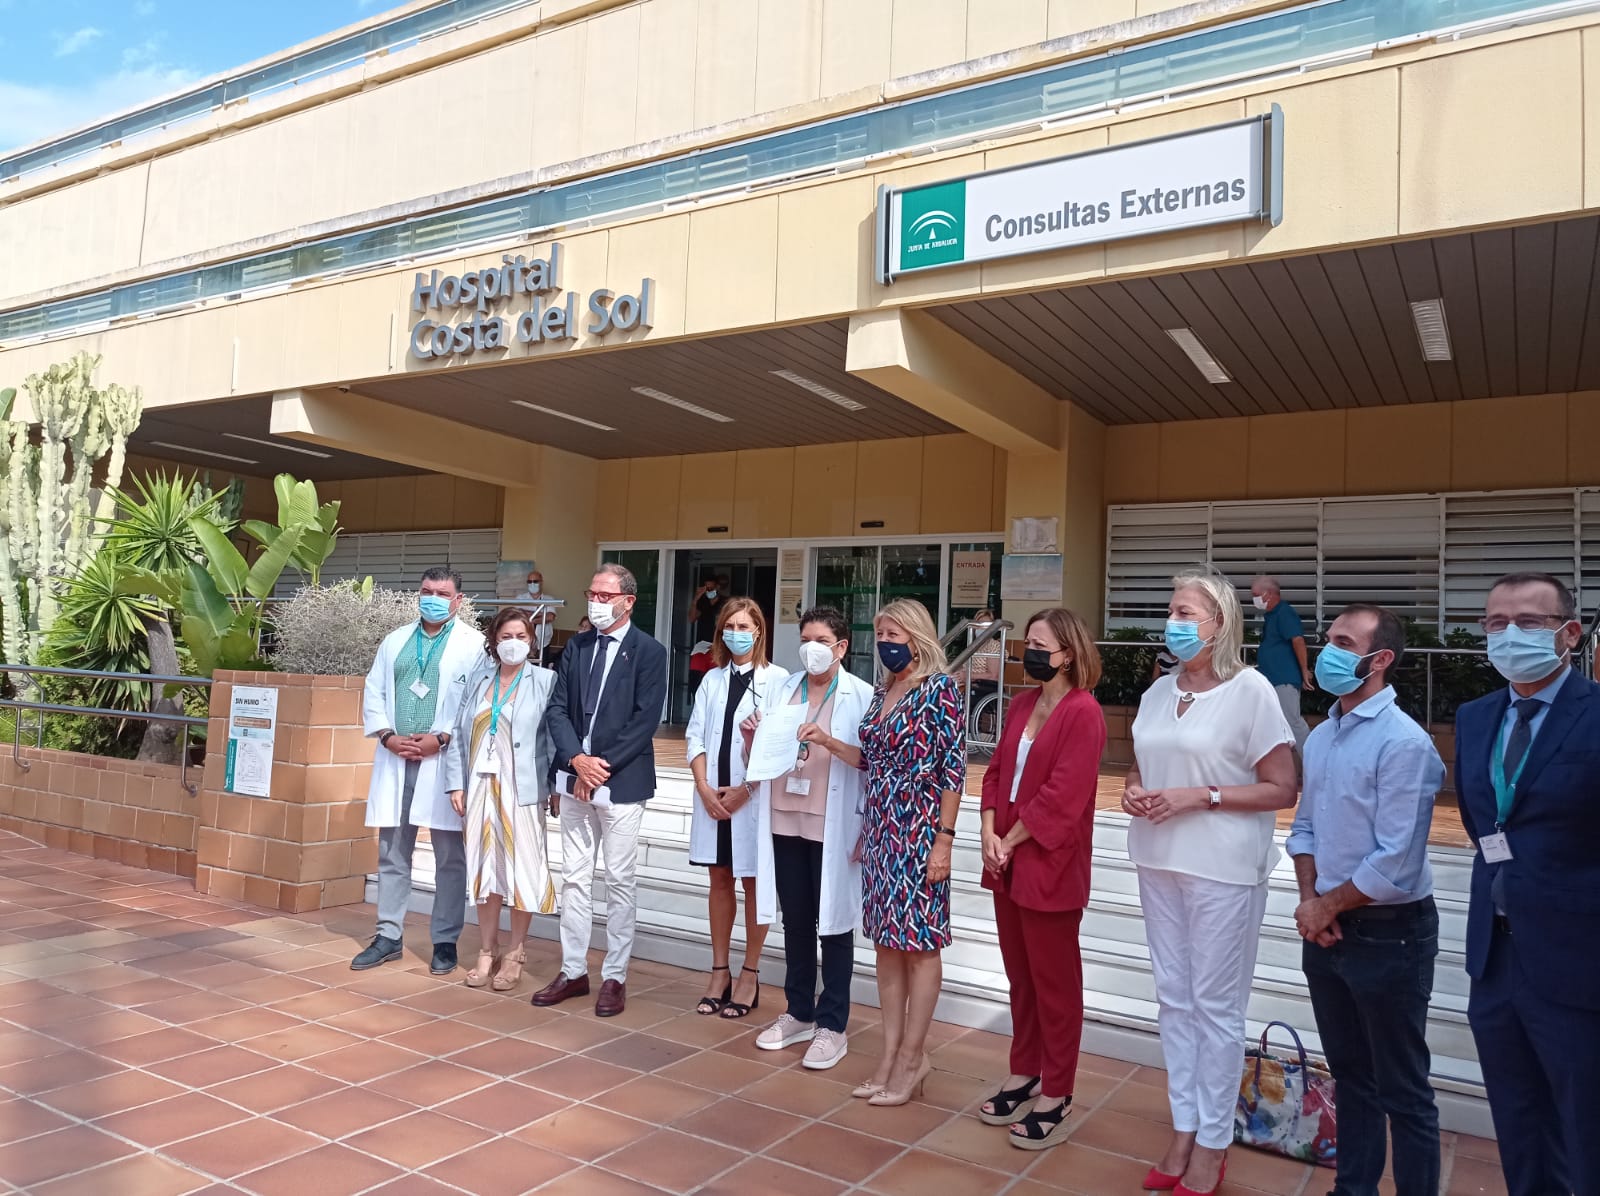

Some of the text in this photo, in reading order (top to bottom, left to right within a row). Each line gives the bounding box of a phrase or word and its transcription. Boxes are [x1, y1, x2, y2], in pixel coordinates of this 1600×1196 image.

[985, 177, 1245, 242] Consultas Externas
[413, 242, 565, 313] Hospital
[410, 277, 656, 361] Costa del Sol
